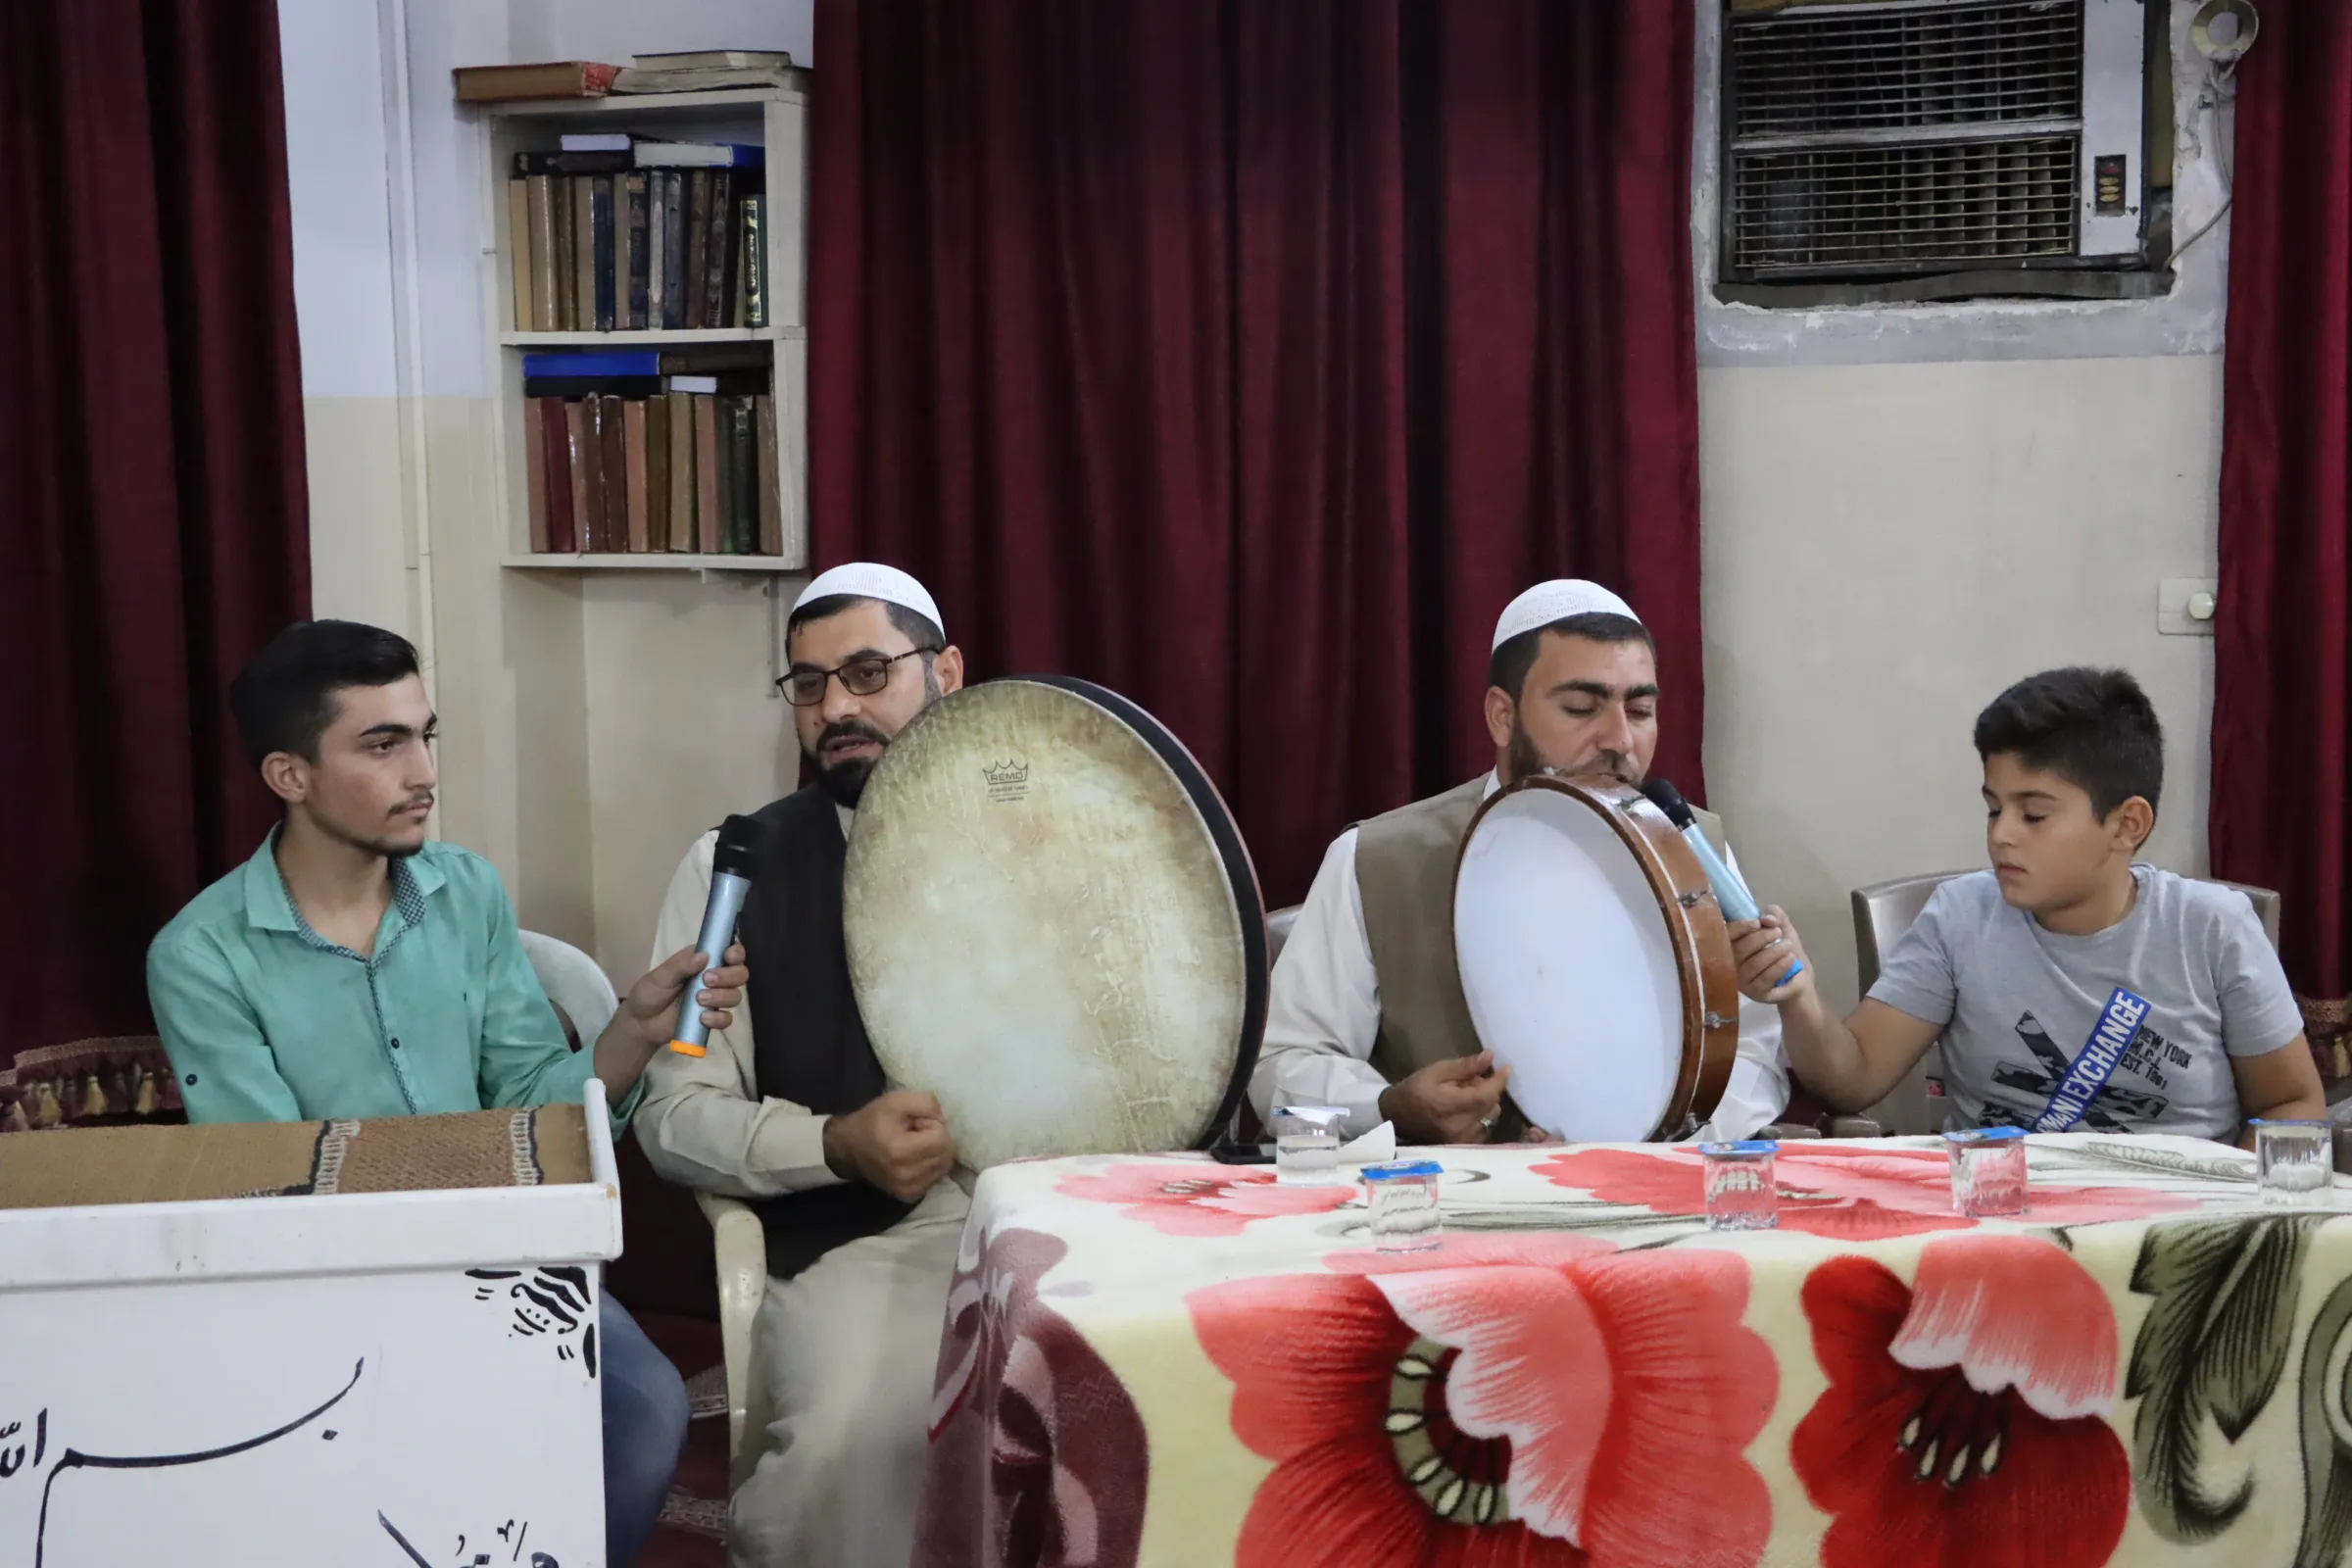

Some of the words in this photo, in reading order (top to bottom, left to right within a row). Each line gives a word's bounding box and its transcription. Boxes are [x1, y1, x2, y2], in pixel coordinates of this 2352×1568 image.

[991, 771, 1024, 782] REMO
[2061, 992, 2145, 1101] EXCHANGE
[2135, 1024, 2164, 1050] NEW
[2163, 1040, 2192, 1069] YORK
[2120, 1053, 2143, 1075] EST.
